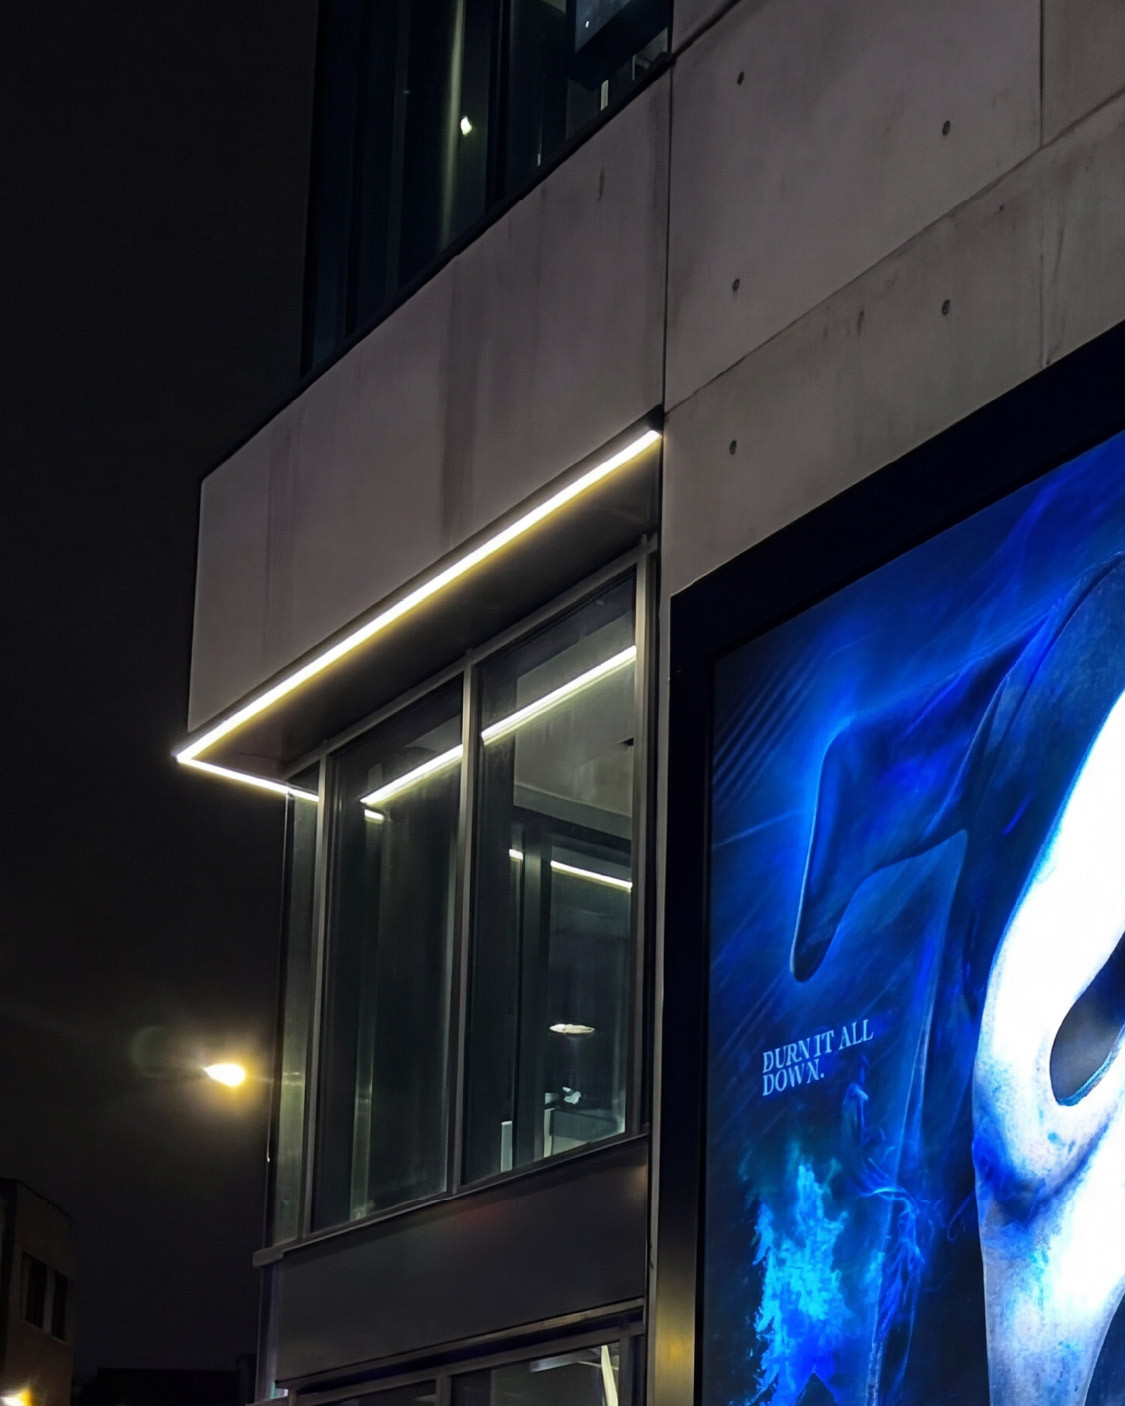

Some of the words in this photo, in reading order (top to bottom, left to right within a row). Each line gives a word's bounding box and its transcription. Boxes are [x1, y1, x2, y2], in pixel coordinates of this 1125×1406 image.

[813, 1029, 835, 1058] IT
[838, 1018, 875, 1051] ALL
[762, 1058, 825, 1097] DOWN.
